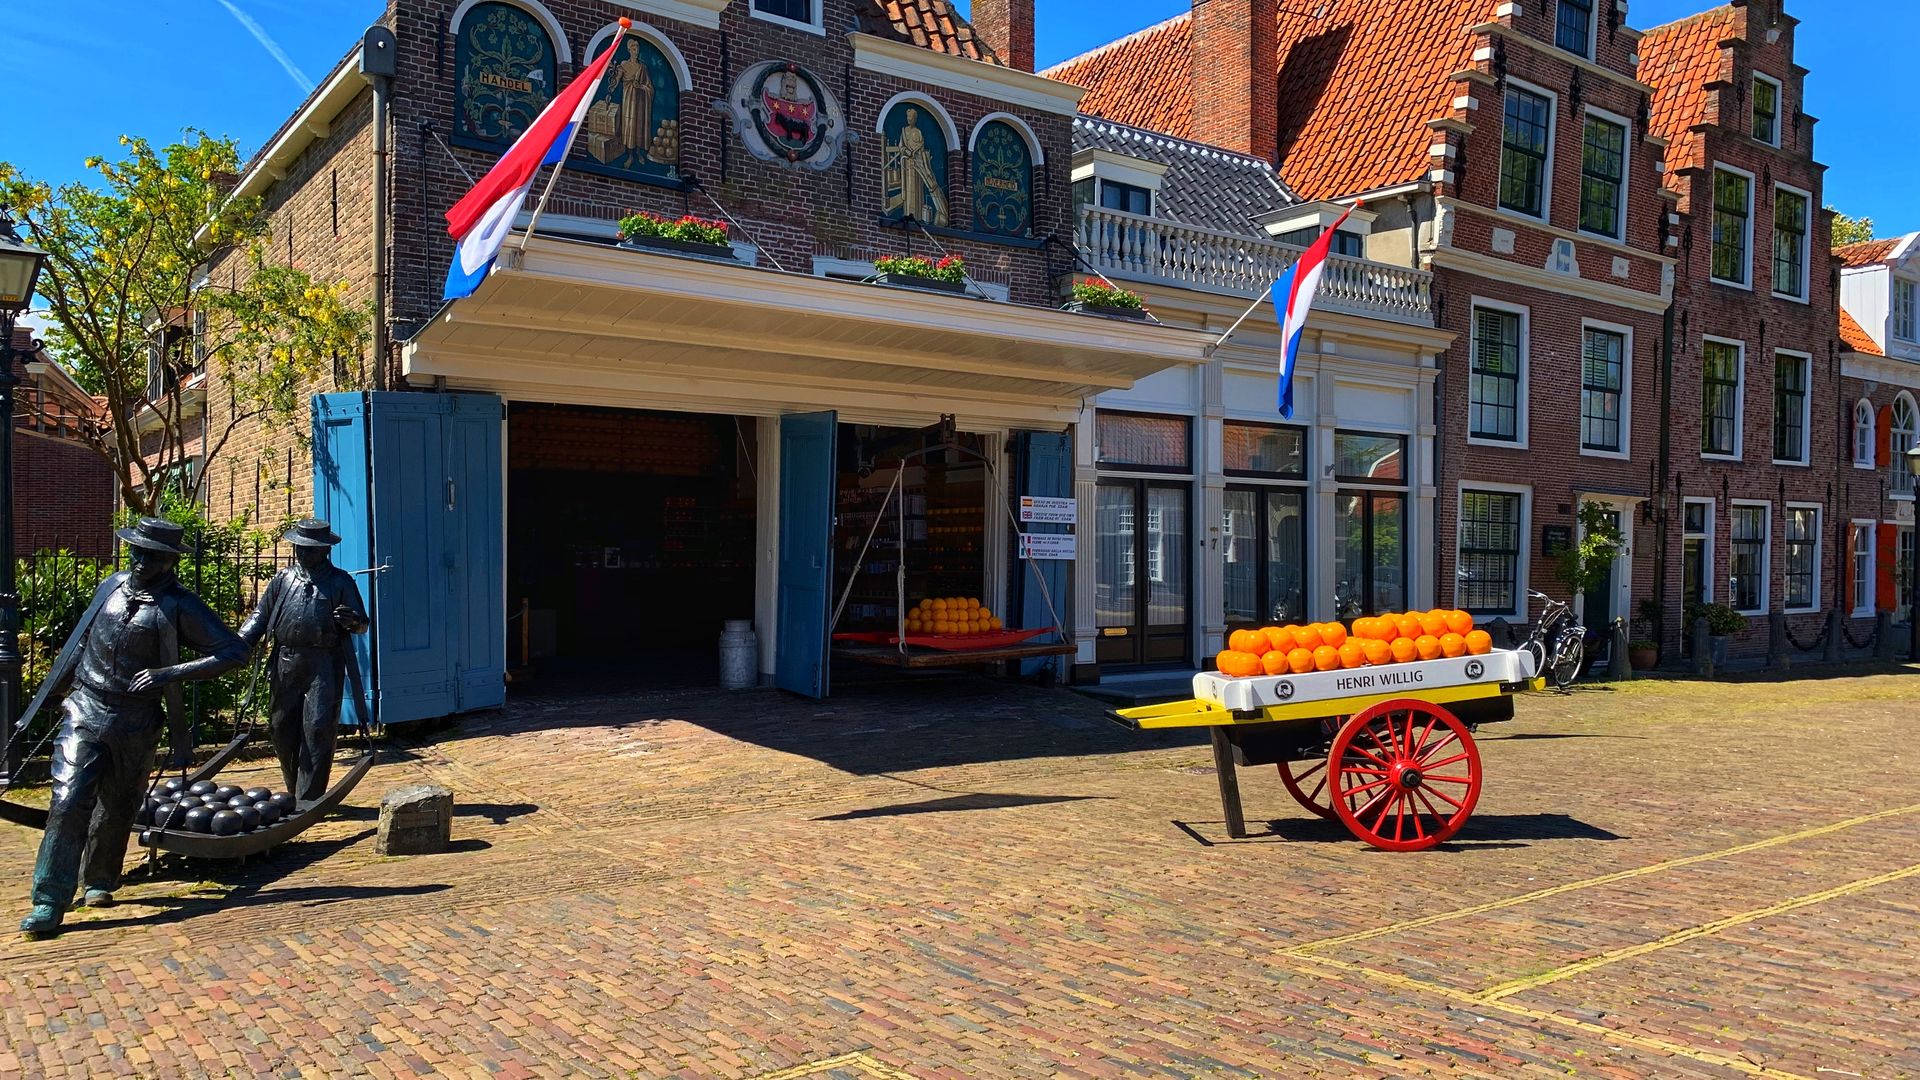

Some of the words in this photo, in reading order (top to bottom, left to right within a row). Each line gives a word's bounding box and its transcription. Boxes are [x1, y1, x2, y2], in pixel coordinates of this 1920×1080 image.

[482, 73, 528, 91] HANDEL
[1337, 675, 1375, 690] HENRI
[1379, 670, 1423, 686] WILLIG
